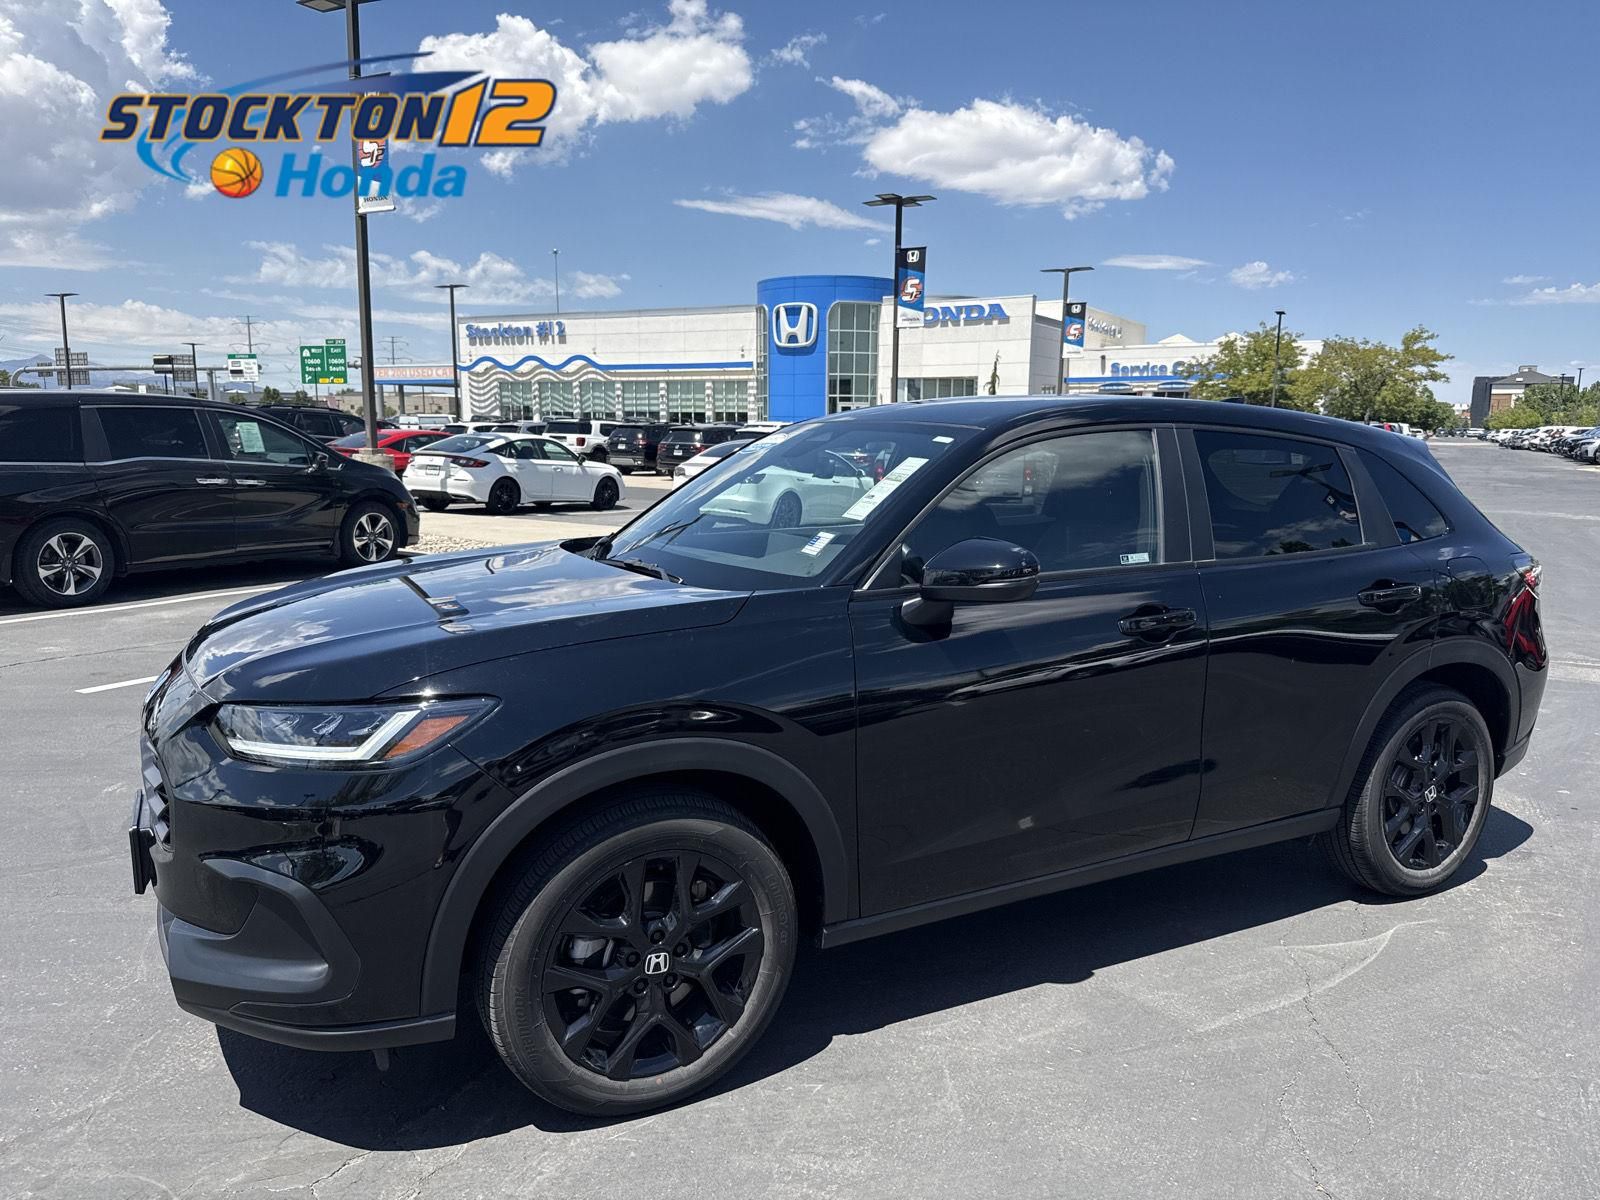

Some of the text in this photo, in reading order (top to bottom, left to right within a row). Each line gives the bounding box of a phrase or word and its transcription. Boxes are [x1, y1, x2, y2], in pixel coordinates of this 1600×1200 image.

[923, 303, 1009, 326] ONDA
[465, 322, 534, 338] Stockton
[409, 367, 433, 378] USED
[1111, 361, 1167, 377] Service
